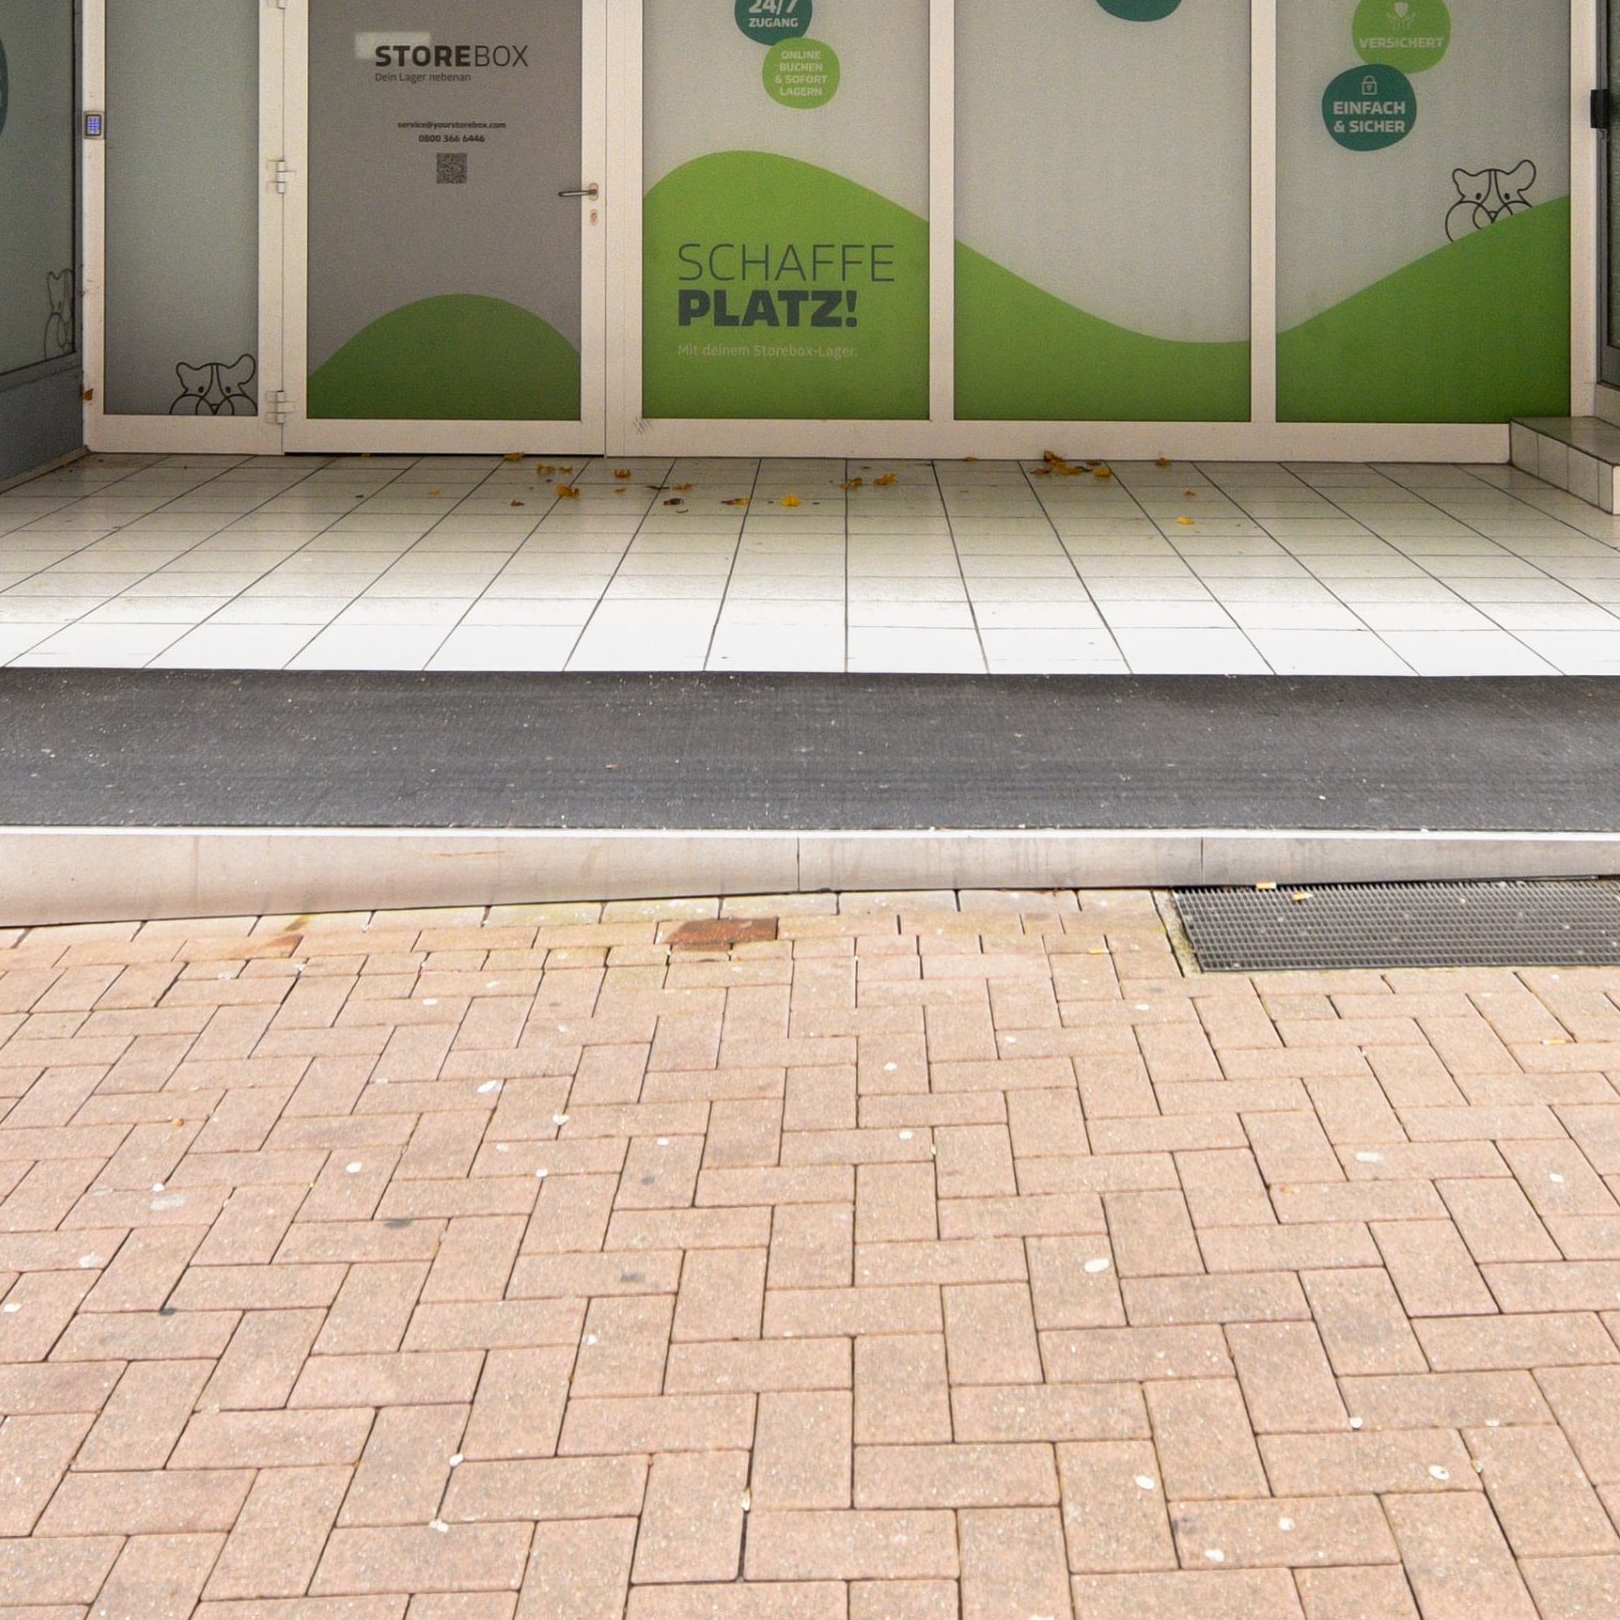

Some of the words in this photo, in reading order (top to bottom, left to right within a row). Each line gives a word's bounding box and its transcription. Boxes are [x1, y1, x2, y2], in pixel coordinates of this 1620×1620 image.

[748, 18, 799, 28] ZUGANG
[1358, 36, 1444, 49] VERSICHERT
[375, 45, 529, 67] STOREBOX
[780, 50, 821, 60] ONLINE
[780, 62, 823, 72] BUCHEN
[375, 72, 397, 82] Dein
[399, 72, 426, 84] Lager
[429, 72, 472, 82] nebenan
[774, 75, 782, 84] &
[785, 75, 828, 84] SOFORT
[780, 87, 823, 96] LAGERN
[1333, 101, 1406, 115] EINFACH
[1333, 120, 1346, 133] &
[1349, 120, 1406, 133] SICHER
[678, 243, 895, 282] SCHAFFE
[678, 289, 858, 328] PLATZ!
[678, 343, 699, 357] Mit
[702, 343, 750, 357] deinem
